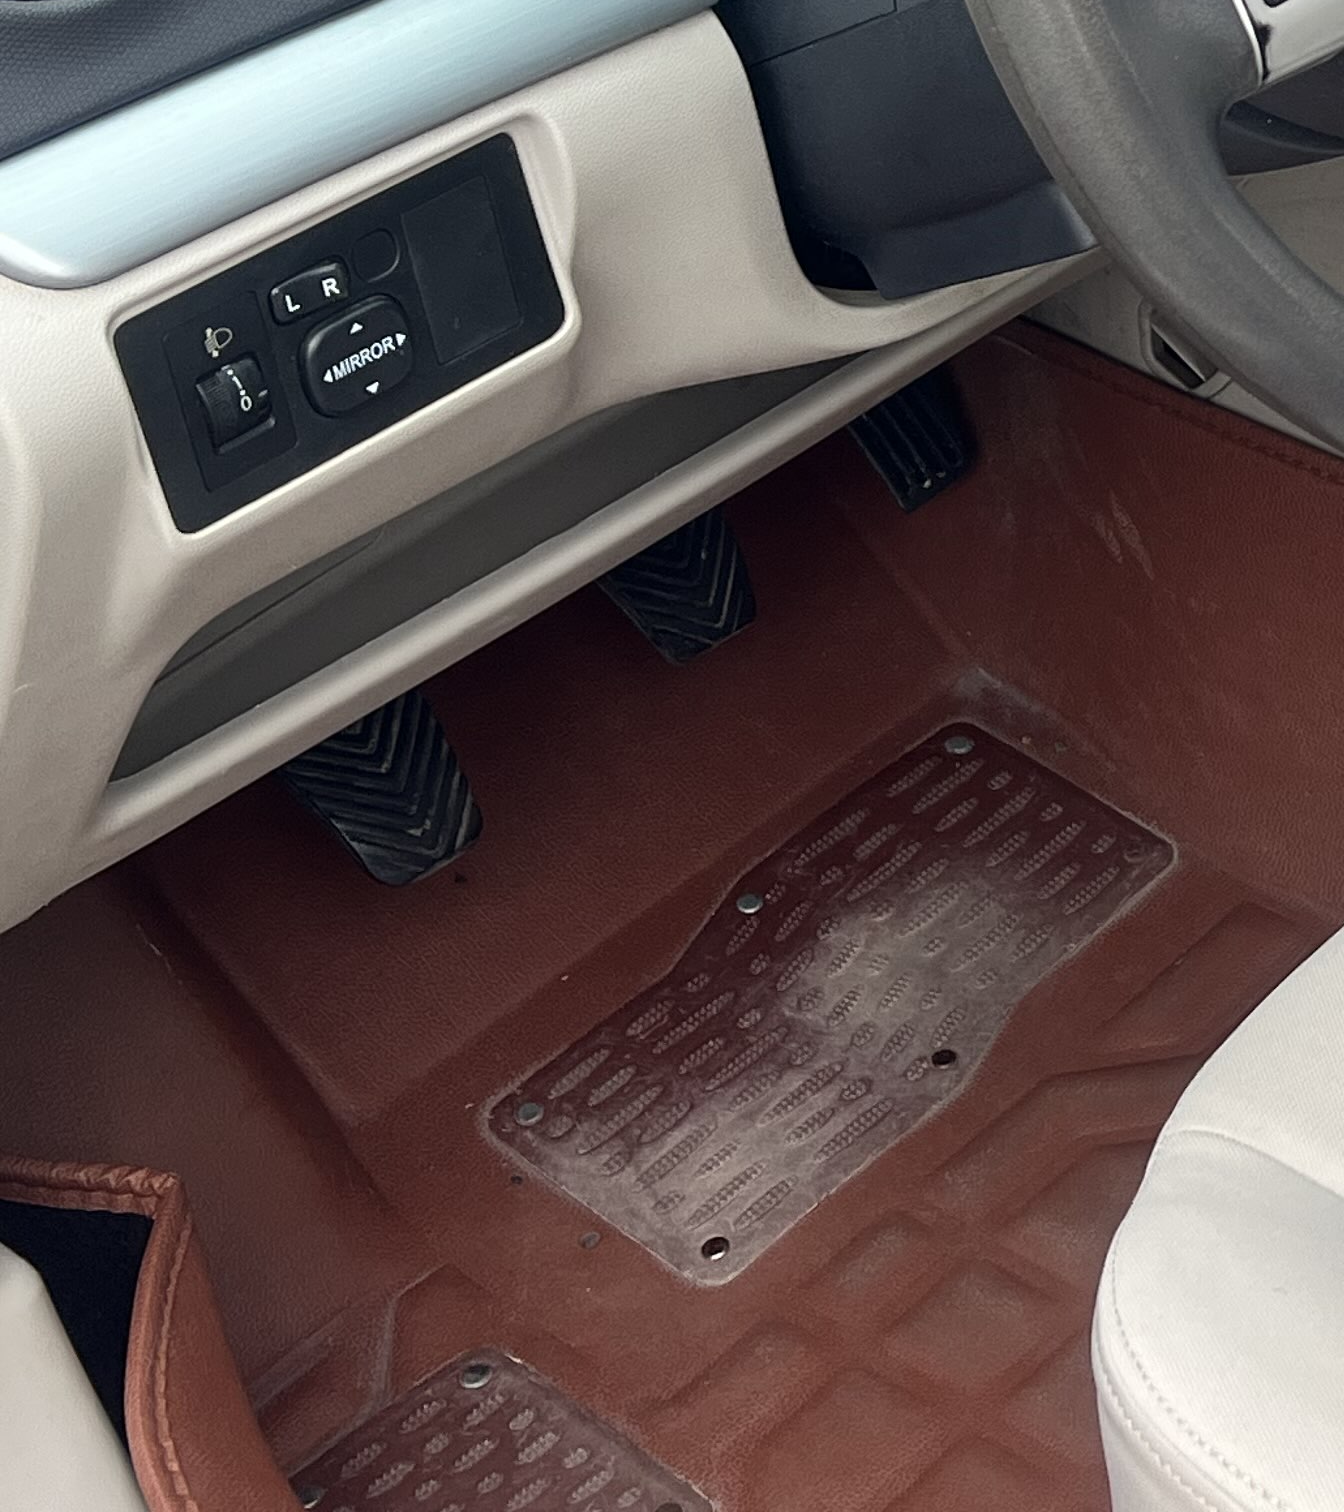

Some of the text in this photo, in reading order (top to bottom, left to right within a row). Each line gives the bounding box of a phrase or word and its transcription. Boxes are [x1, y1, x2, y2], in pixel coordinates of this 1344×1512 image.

[285, 277, 340, 313] L R
[333, 335, 396, 380] MIRROR
